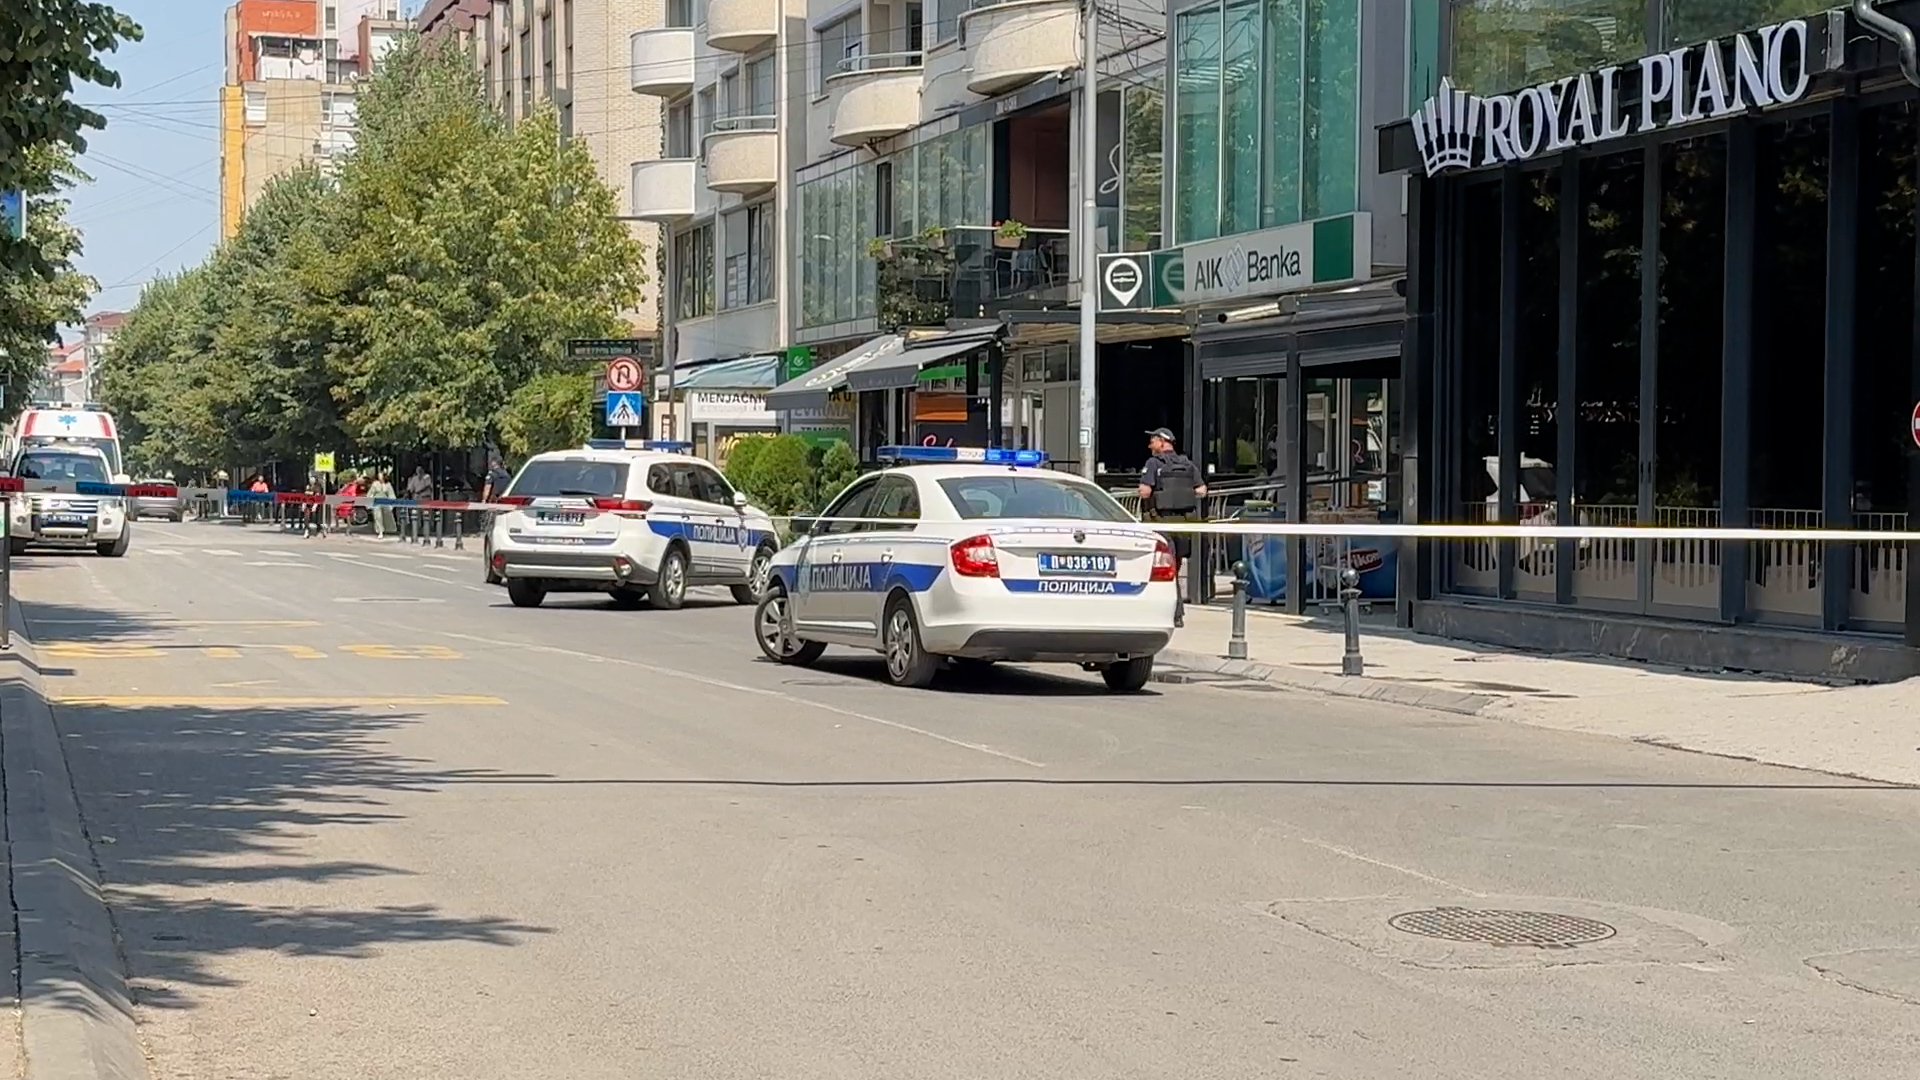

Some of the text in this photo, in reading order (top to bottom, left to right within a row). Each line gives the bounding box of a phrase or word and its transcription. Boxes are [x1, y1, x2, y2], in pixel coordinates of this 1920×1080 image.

[1481, 20, 1809, 166] ROYAL PIANO
[1194, 245, 1302, 292] AIK Banka
[694, 525, 735, 543] ПОЛИЦИЈА
[811, 565, 872, 591] ПОЛИЦИЈА
[1037, 580, 1116, 595] ПОЛИЦИЈА
